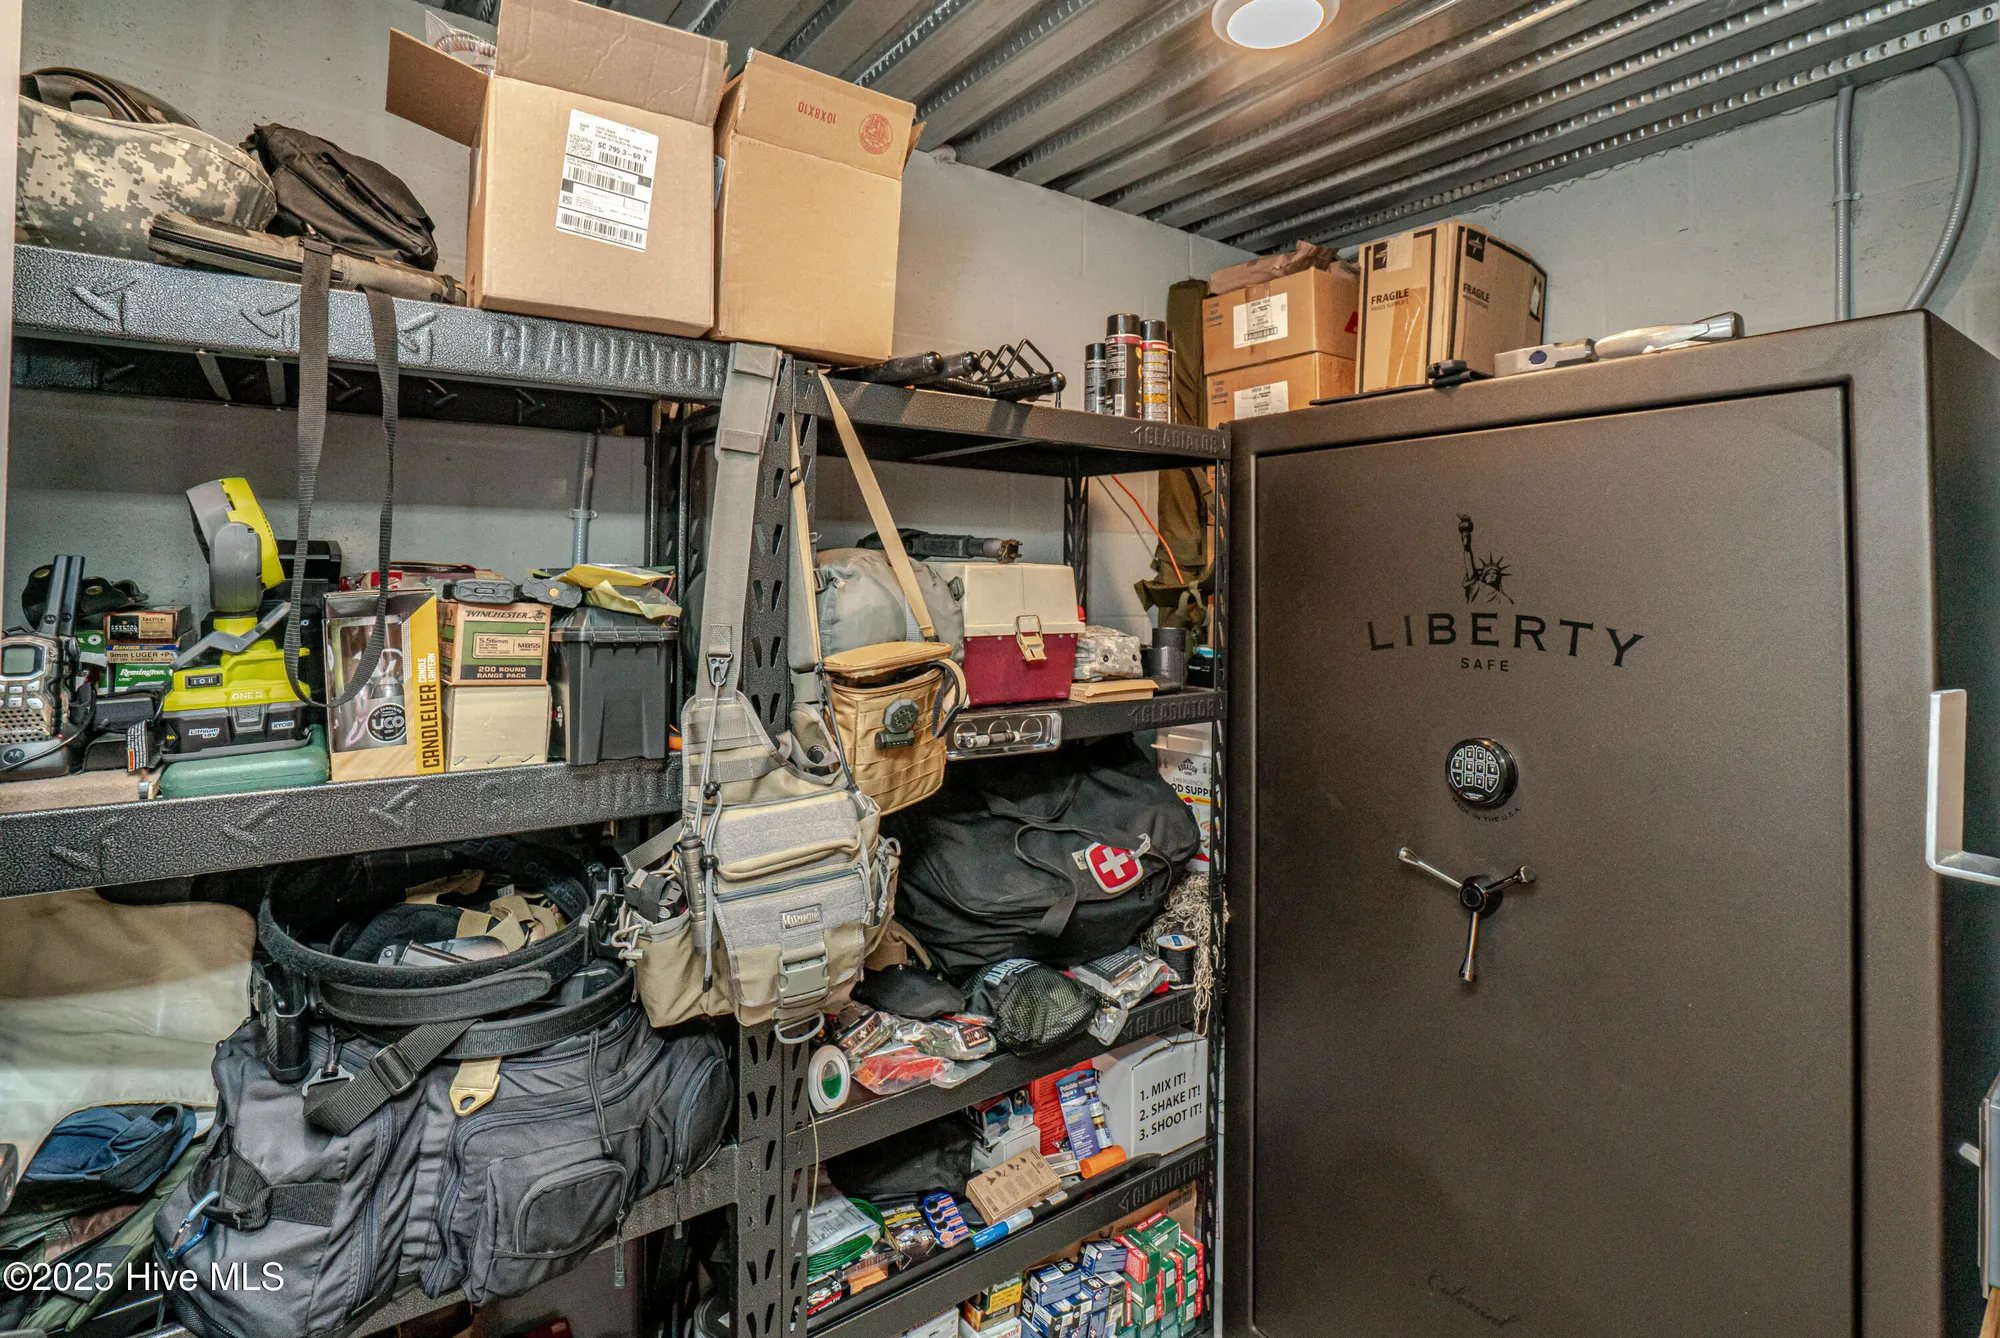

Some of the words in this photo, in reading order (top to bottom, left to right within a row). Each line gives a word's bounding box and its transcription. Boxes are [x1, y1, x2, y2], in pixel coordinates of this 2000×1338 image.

[798, 101, 836, 124] 10X8X10
[597, 141, 607, 149] SC
[608, 145, 621, 154] 295
[1371, 288, 1410, 305] FRAGILE
[1463, 282, 1490, 302] FRAGILE
[465, 609, 528, 619] WINCHESTER
[1367, 612, 1645, 668] LIBERTY
[120, 668, 166, 677] Remington
[427, 653, 436, 682] LANTERN
[1460, 657, 1509, 672] SAFE
[273, 721, 295, 729] RYOBI
[371, 715, 405, 730] UCO
[419, 683, 440, 768] CANDLELIER
[1139, 1090, 1149, 1102] 1.
[1151, 1079, 1171, 1097] MIX
[1173, 1072, 1187, 1088] IT!
[1139, 1109, 1149, 1122] 2.
[1151, 1093, 1186, 1117] SHAKE
[1188, 1085, 1201, 1100] IT!
[1139, 1129, 1149, 1141] 3.
[1151, 1110, 1187, 1136] SHOOT
[1189, 1103, 1203, 1118] IT!
